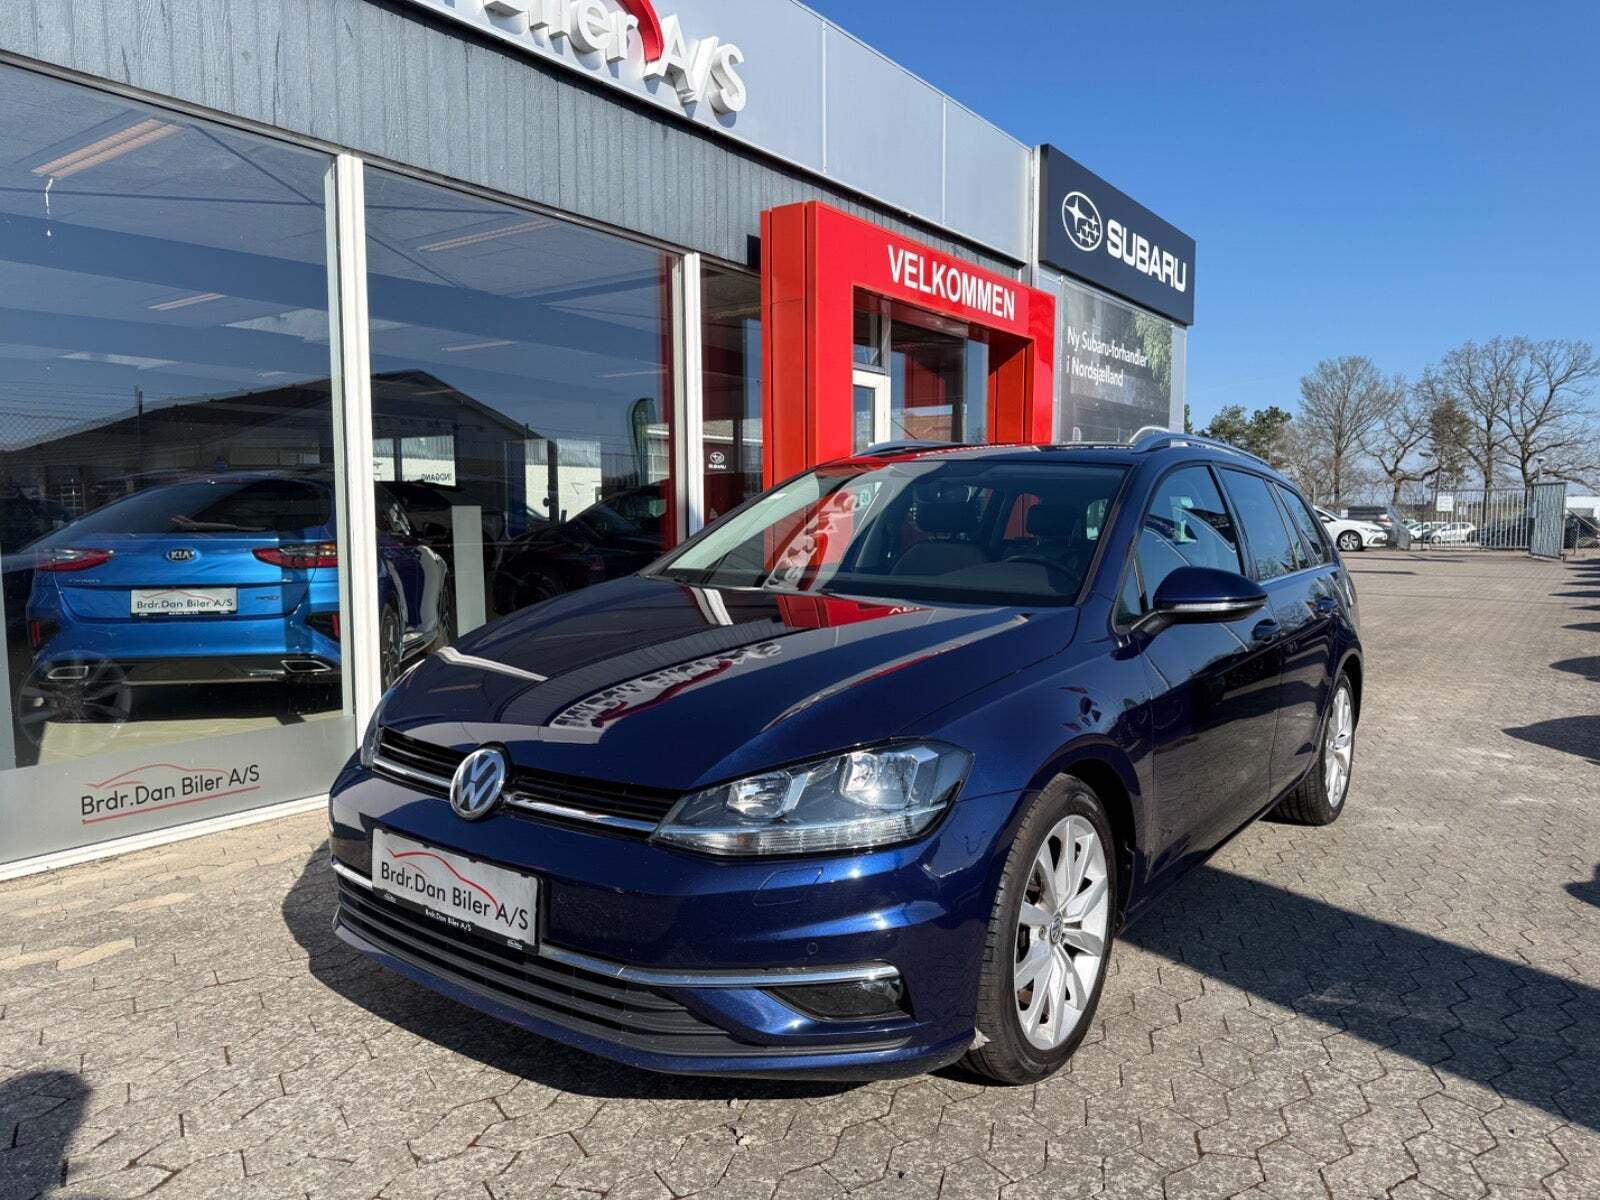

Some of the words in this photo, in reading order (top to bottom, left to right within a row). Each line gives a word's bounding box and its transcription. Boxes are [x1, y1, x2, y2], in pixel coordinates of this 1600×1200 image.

[643, 14, 746, 114] A/S
[1107, 219, 1187, 293] SUBARU
[888, 245, 1015, 321] VELKOMMEN
[1067, 326, 1080, 352] Ny
[1081, 331, 1148, 368] Subaru-forhandler
[1072, 356, 1124, 386] Nordsjælland
[171, 550, 192, 561] KIA
[187, 598, 210, 608] Biler
[214, 598, 233, 607] A/S
[182, 774, 223, 796] Biler
[228, 764, 260, 786] A/S
[452, 886, 490, 917] Biler
[495, 903, 529, 931] A/S
